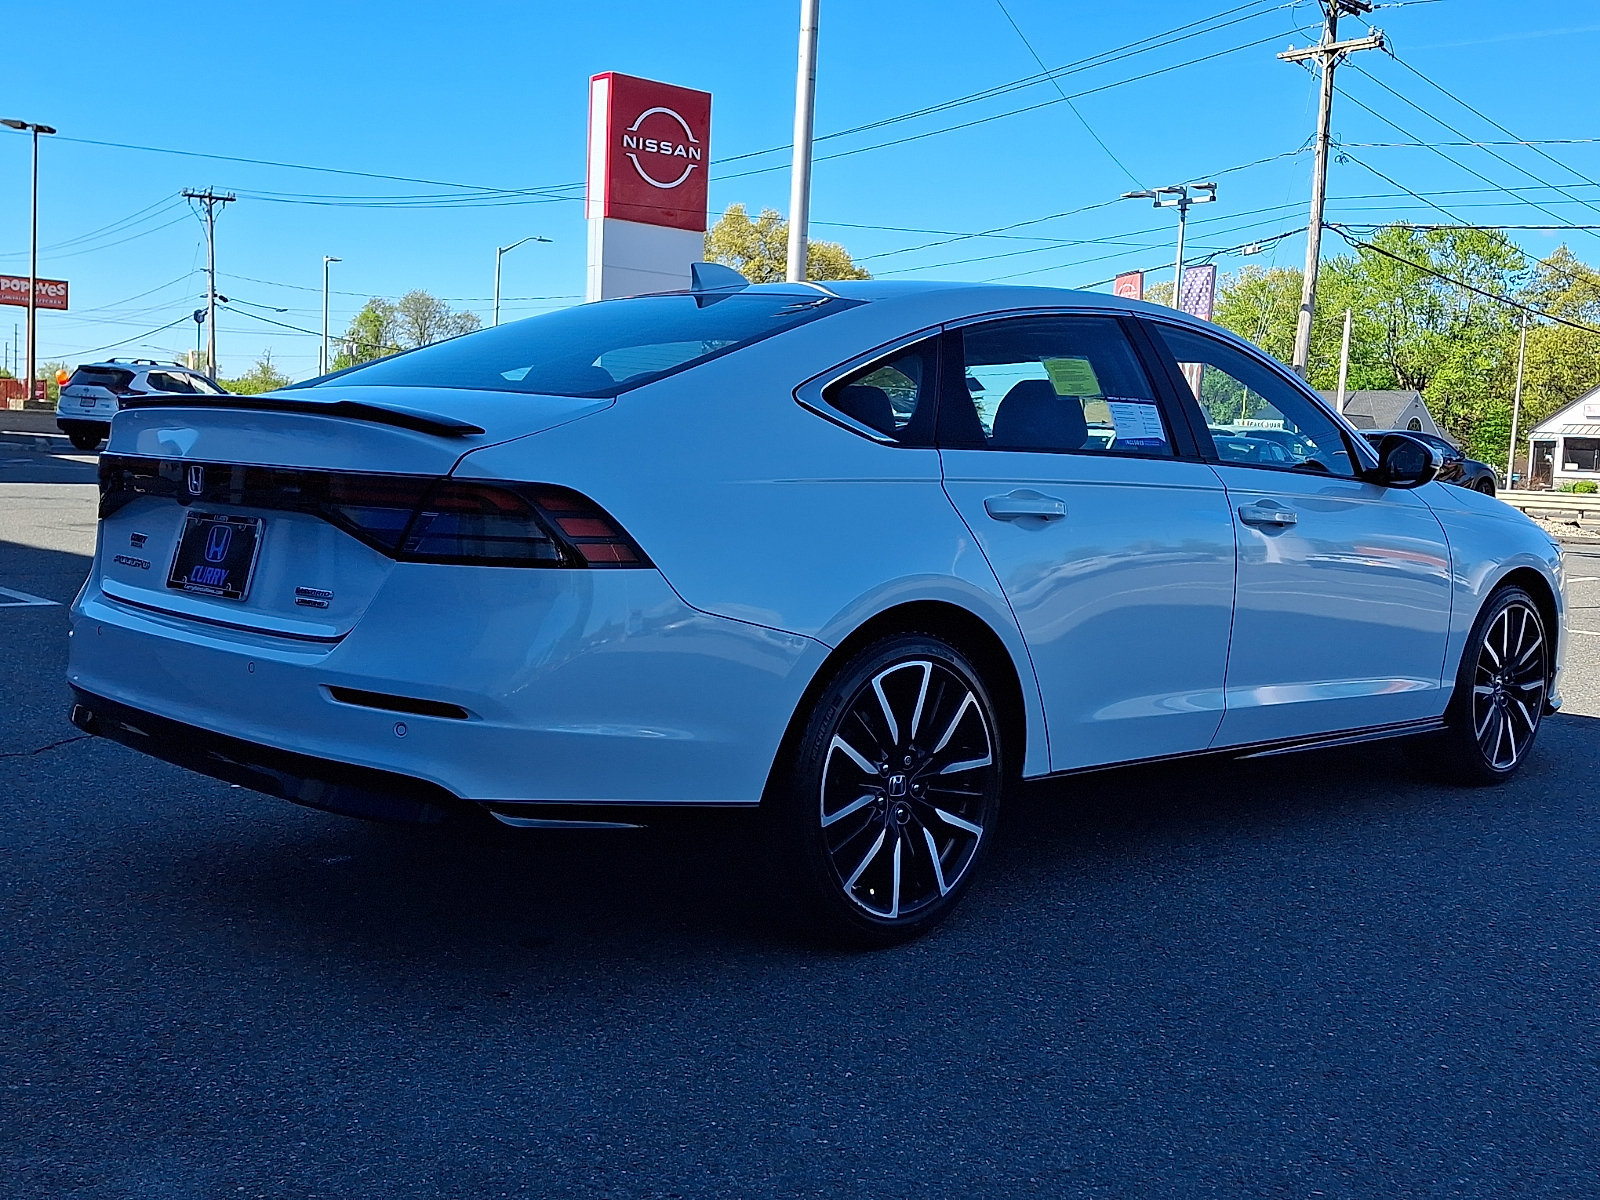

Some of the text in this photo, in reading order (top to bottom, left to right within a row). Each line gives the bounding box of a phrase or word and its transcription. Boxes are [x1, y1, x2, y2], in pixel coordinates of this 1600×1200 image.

[623, 134, 701, 161] NISSAN
[191, 565, 229, 586] CURRY
[812, 706, 834, 761] MICHELIN
